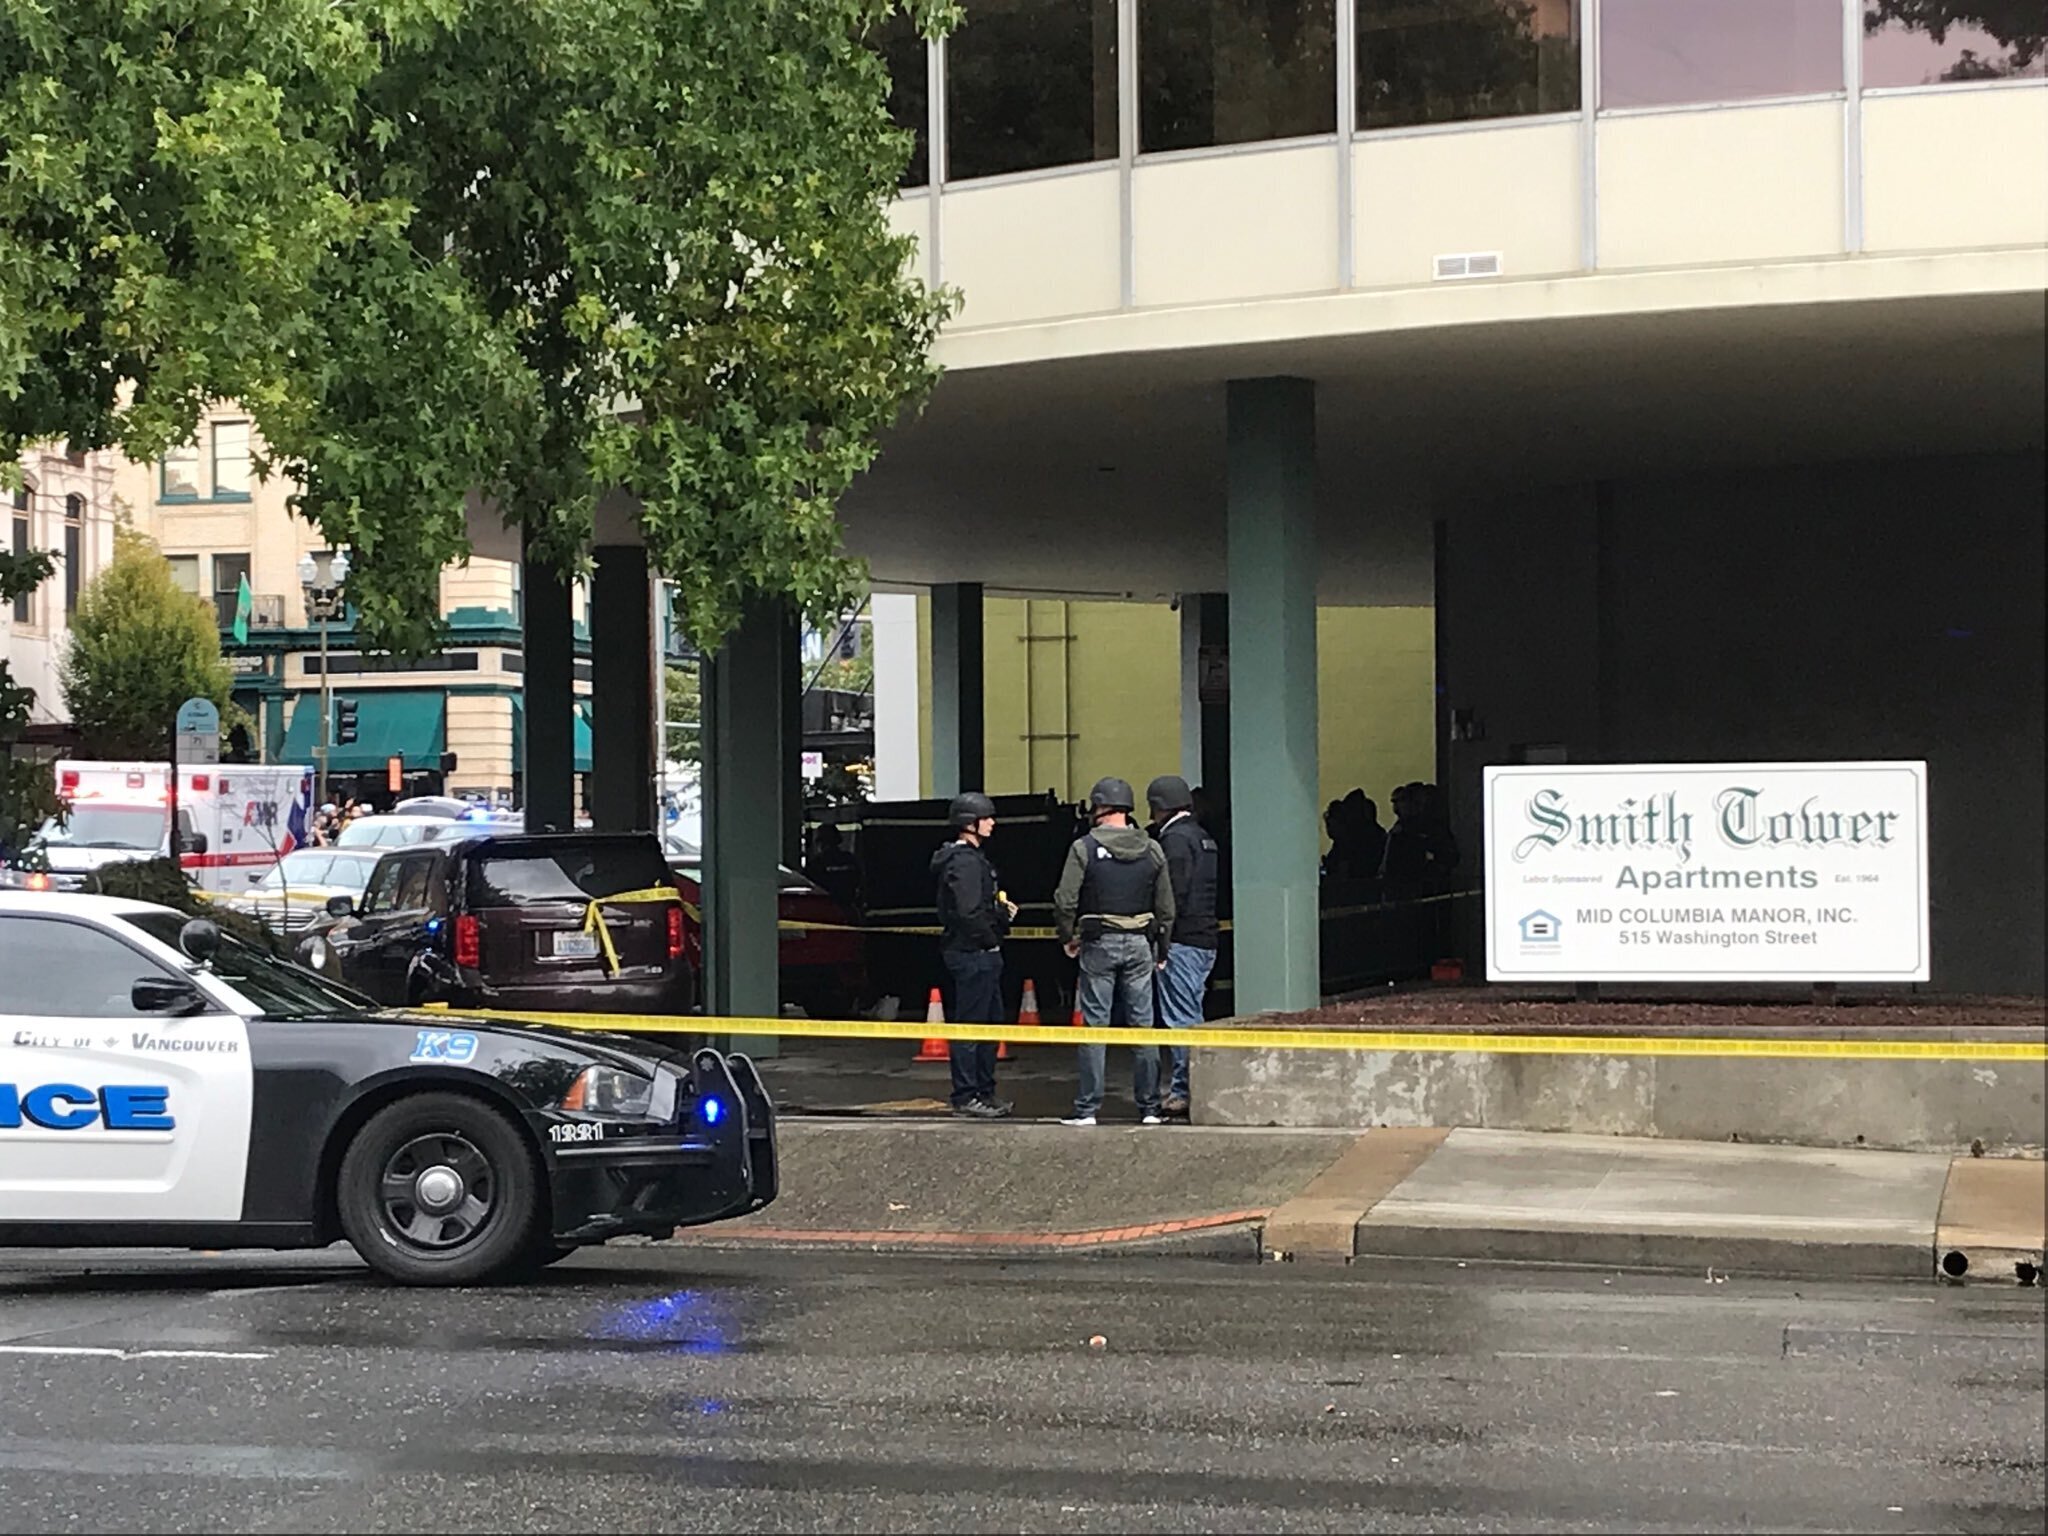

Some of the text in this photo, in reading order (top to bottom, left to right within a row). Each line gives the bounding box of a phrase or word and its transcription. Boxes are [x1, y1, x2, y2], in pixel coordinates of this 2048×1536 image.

[1514, 786, 1900, 865] Smith Tower
[1615, 864, 1819, 895] Apartments
[1576, 907, 1858, 925] MID COLUMBIA MANOR, INC.
[1619, 929, 1818, 948] 515 Washington Street
[410, 1030, 479, 1065] K9
